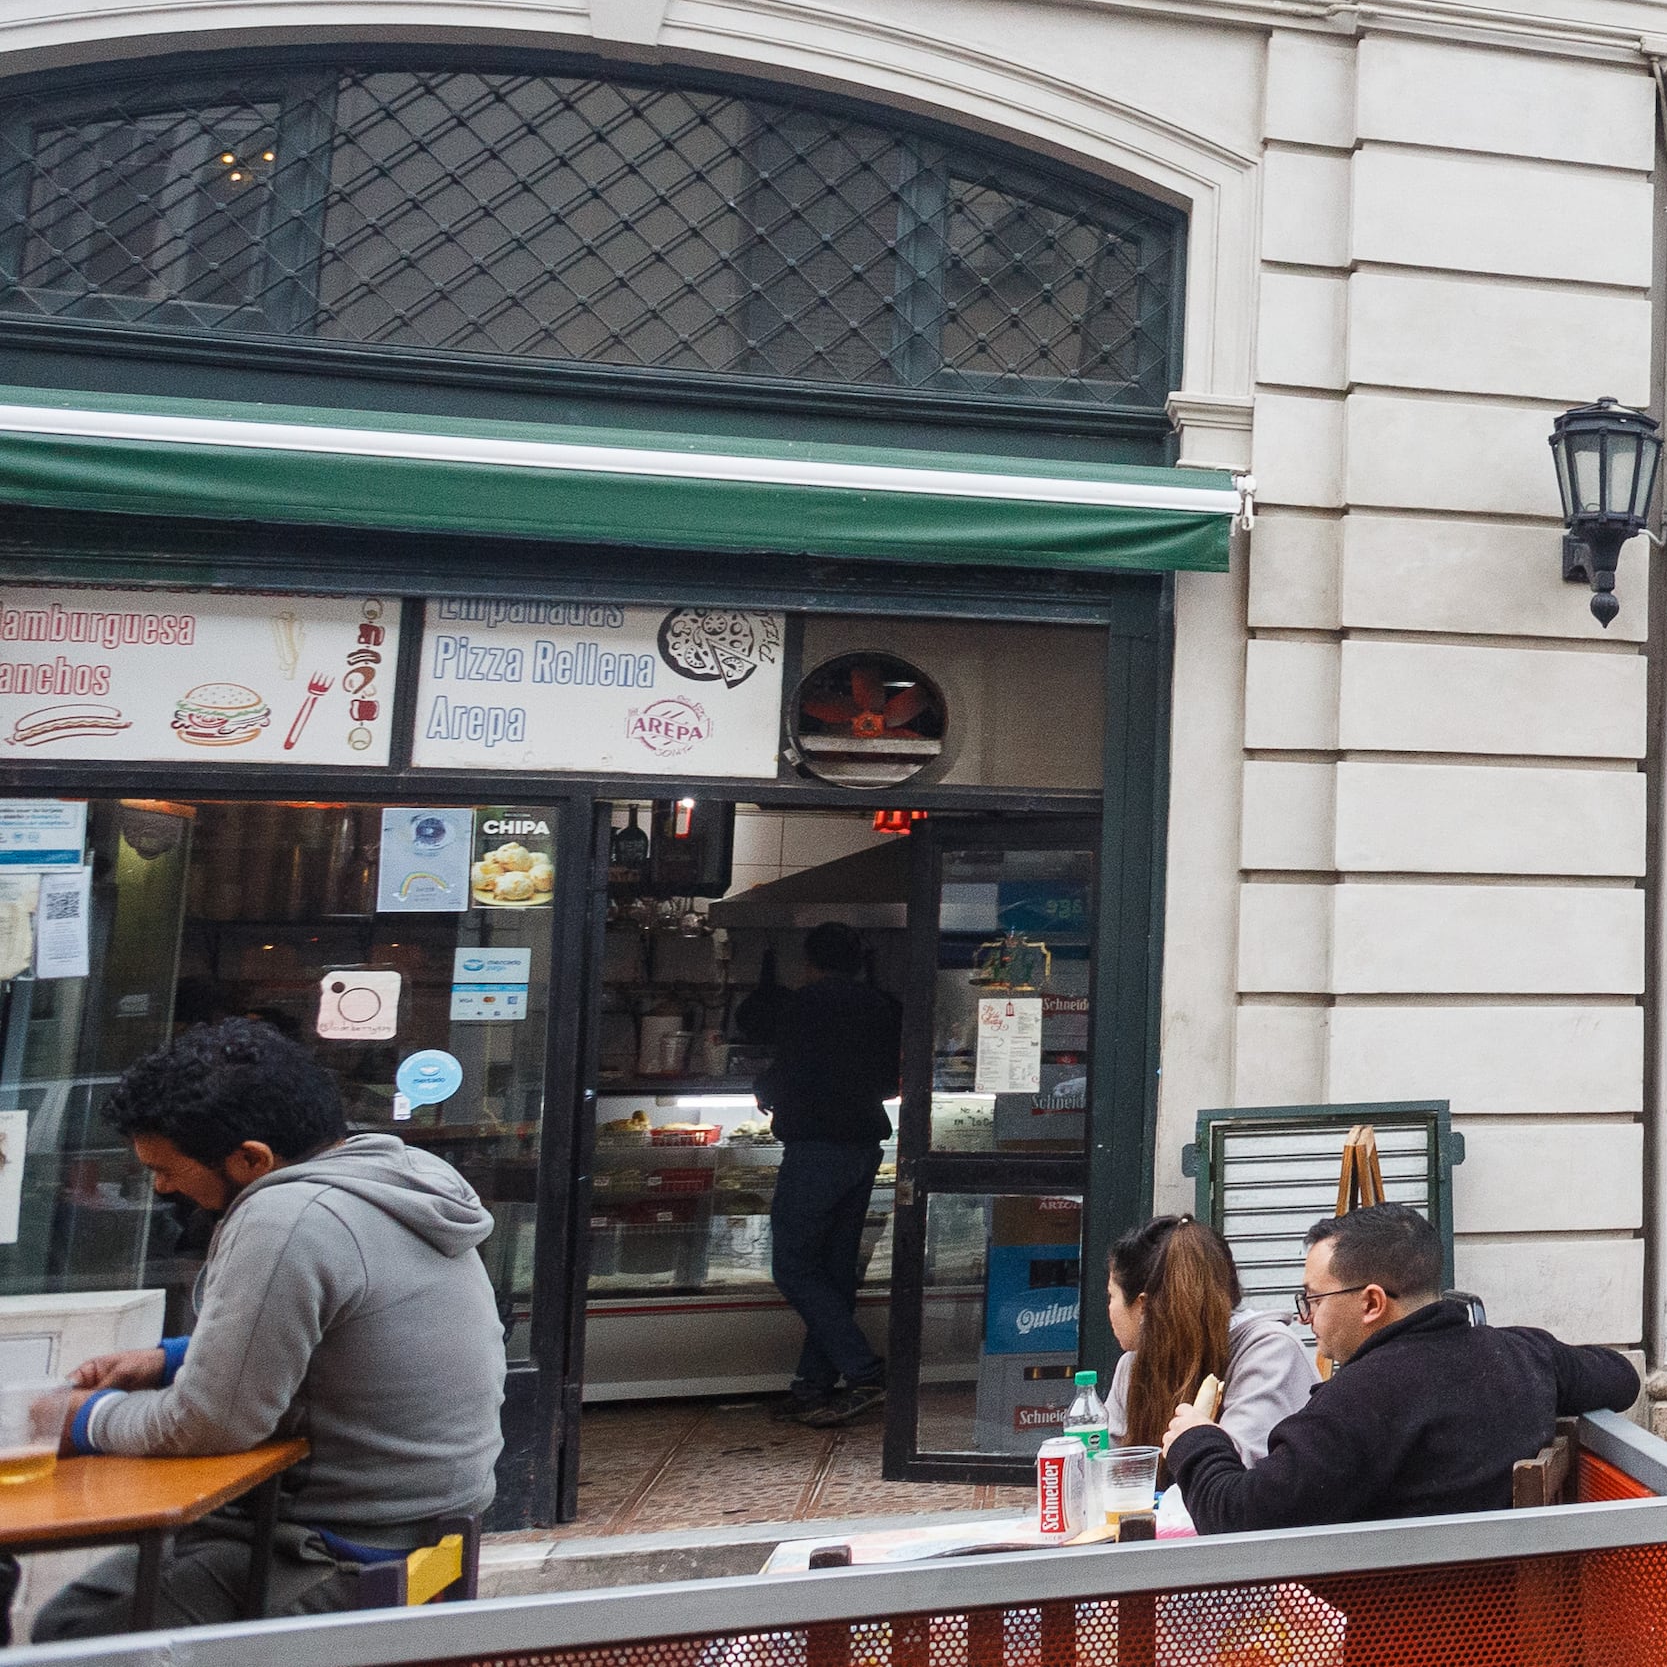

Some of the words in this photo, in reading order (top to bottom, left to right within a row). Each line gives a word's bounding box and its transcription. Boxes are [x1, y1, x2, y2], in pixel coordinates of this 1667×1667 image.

[0, 603, 196, 649] amburguesa
[433, 635, 523, 684] Pizza
[531, 640, 656, 689] Rellena
[426, 695, 527, 748] Arepa
[631, 716, 704, 742] AREPA
[483, 820, 550, 835] CHIPA
[1042, 996, 1089, 1012] Schneid
[1031, 1094, 1086, 1112] Schneid
[1039, 1200, 1082, 1210] ARTOI
[1016, 1303, 1081, 1334] Quilme
[1019, 1408, 1066, 1425] Schneid
[1042, 1461, 1059, 1532] Schneider
